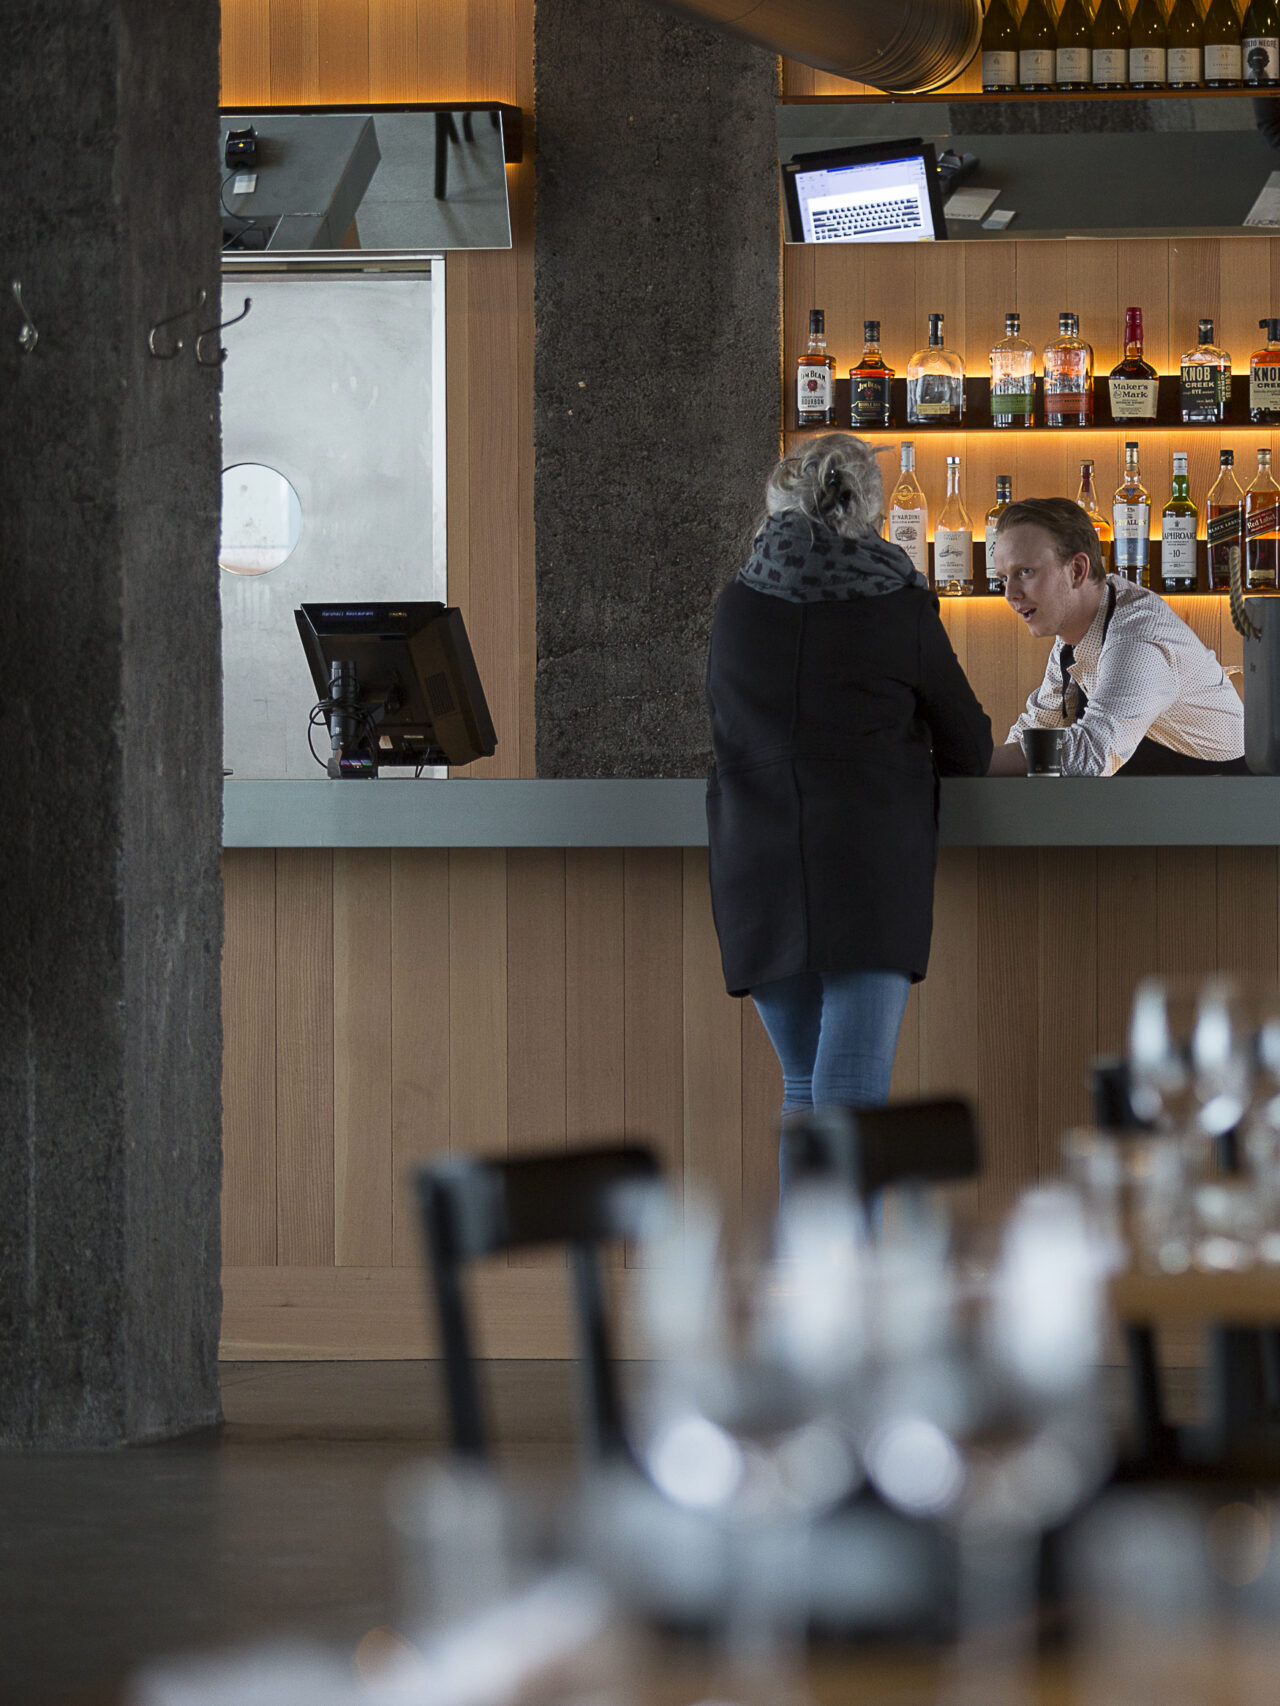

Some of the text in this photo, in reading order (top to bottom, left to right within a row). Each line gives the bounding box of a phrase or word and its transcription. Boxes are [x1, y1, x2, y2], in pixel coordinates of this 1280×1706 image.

[810, 370, 826, 381] BEAM
[1182, 366, 1211, 382] KNOB
[857, 382, 867, 392] JIM
[1112, 383, 1149, 391] Maker's
[1247, 514, 1276, 530] Red Label
[1163, 532, 1196, 540] APHROAIG
[1172, 549, 1181, 558] 10
